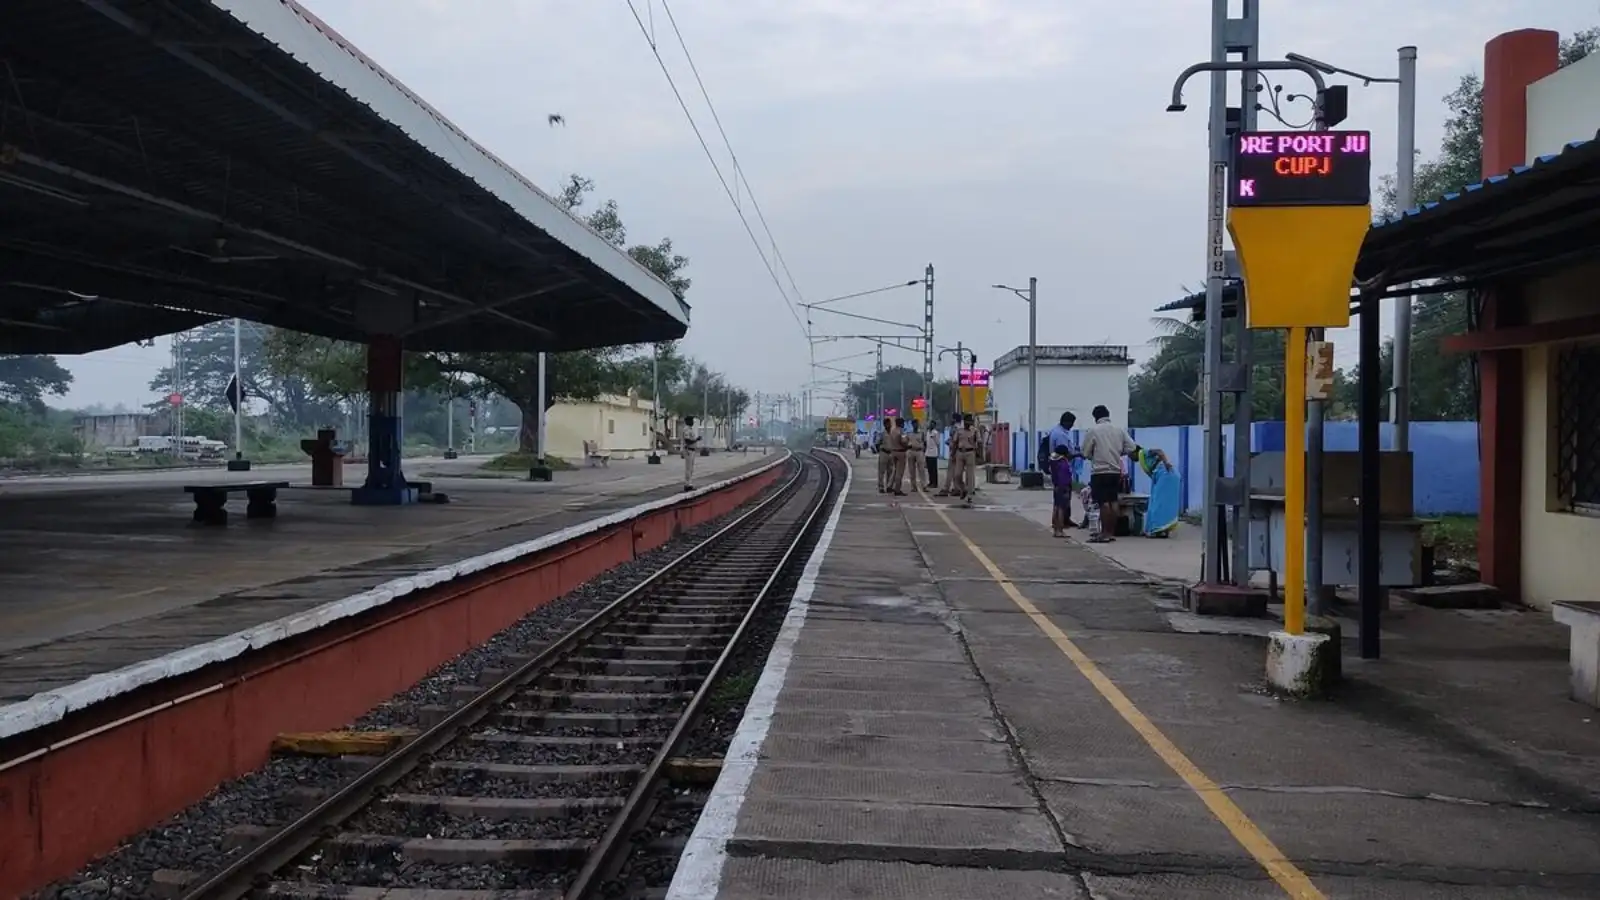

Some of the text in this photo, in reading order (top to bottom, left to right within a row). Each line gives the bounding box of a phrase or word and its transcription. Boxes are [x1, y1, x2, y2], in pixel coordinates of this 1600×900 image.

[1278, 136, 1335, 153] PORT
[1340, 136, 1367, 153] JU
[1275, 157, 1330, 174] CUPJ
[1239, 179, 1255, 197] K
